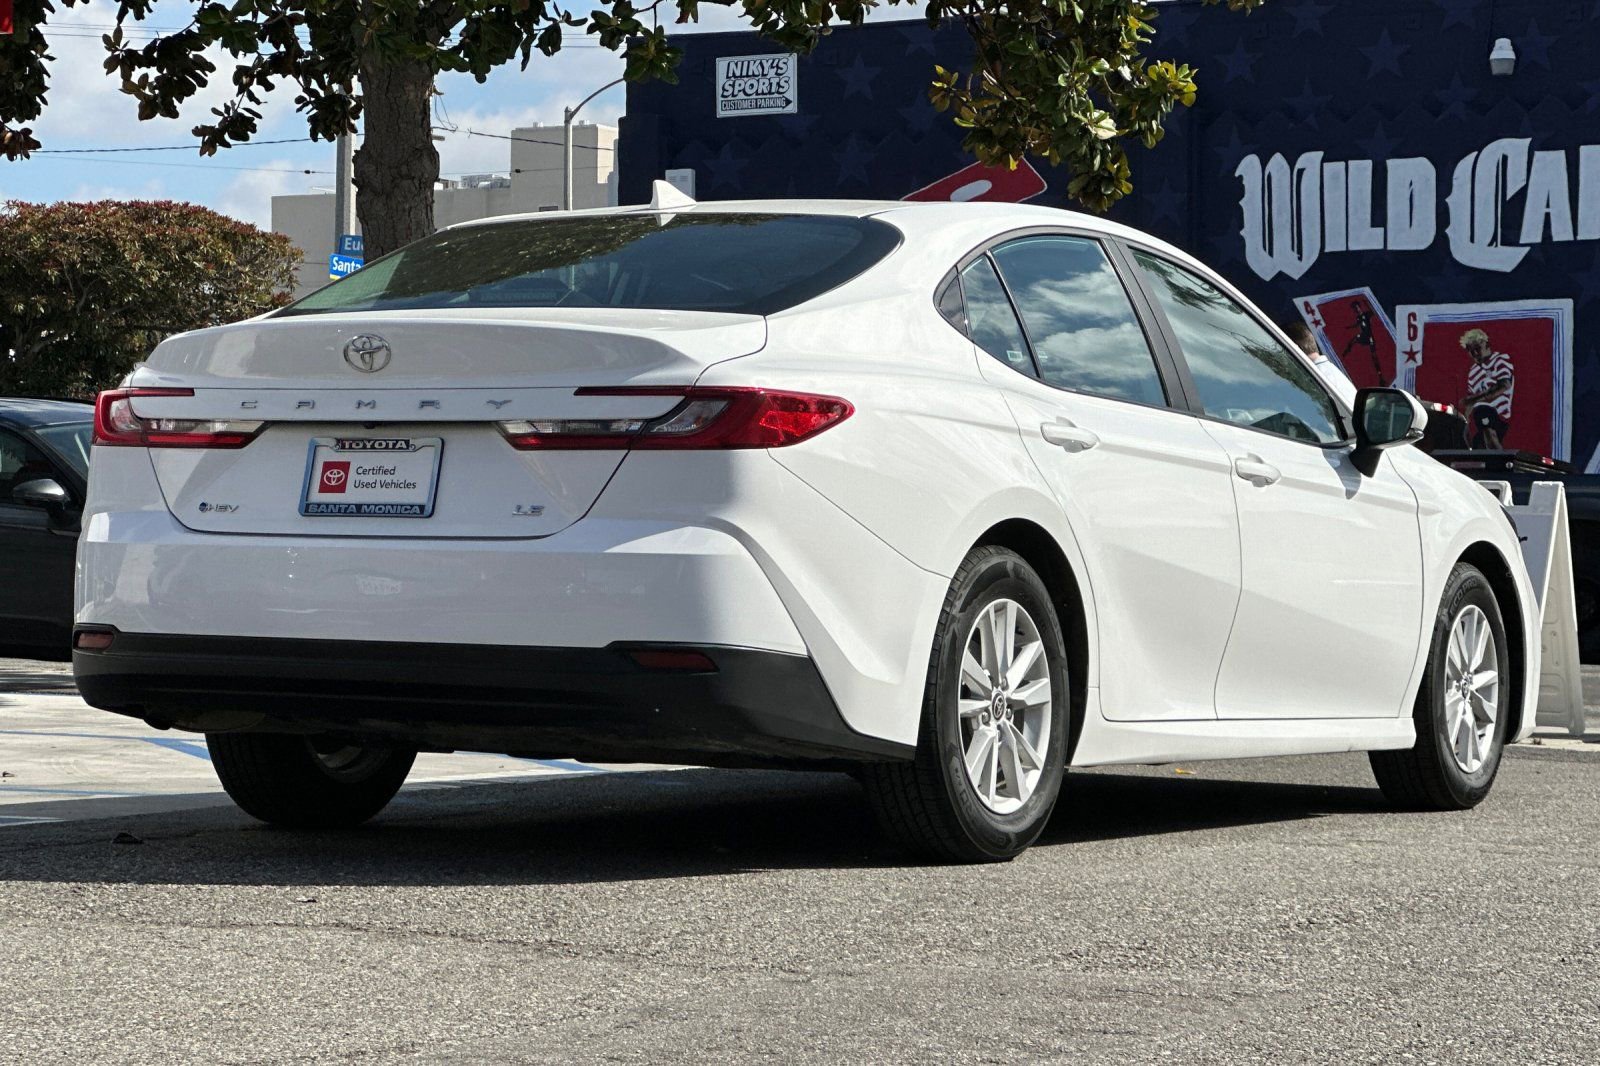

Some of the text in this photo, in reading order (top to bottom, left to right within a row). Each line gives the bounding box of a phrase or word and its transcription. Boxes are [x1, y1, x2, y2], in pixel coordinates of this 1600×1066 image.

[726, 57, 789, 79] NIKY'S
[721, 76, 791, 98] SPORTS
[722, 97, 786, 110] CUSTOMER PARKING
[1234, 150, 1437, 282] WILD
[344, 237, 363, 251] Eu
[1303, 300, 1316, 316] 4
[1407, 311, 1419, 342] 6
[240, 399, 512, 410] CAMRY
[341, 440, 408, 449] TOYOTA
[356, 466, 397, 475] Certified
[353, 480, 417, 489] Used Vehicles
[308, 504, 421, 515] SANTA MONICA
